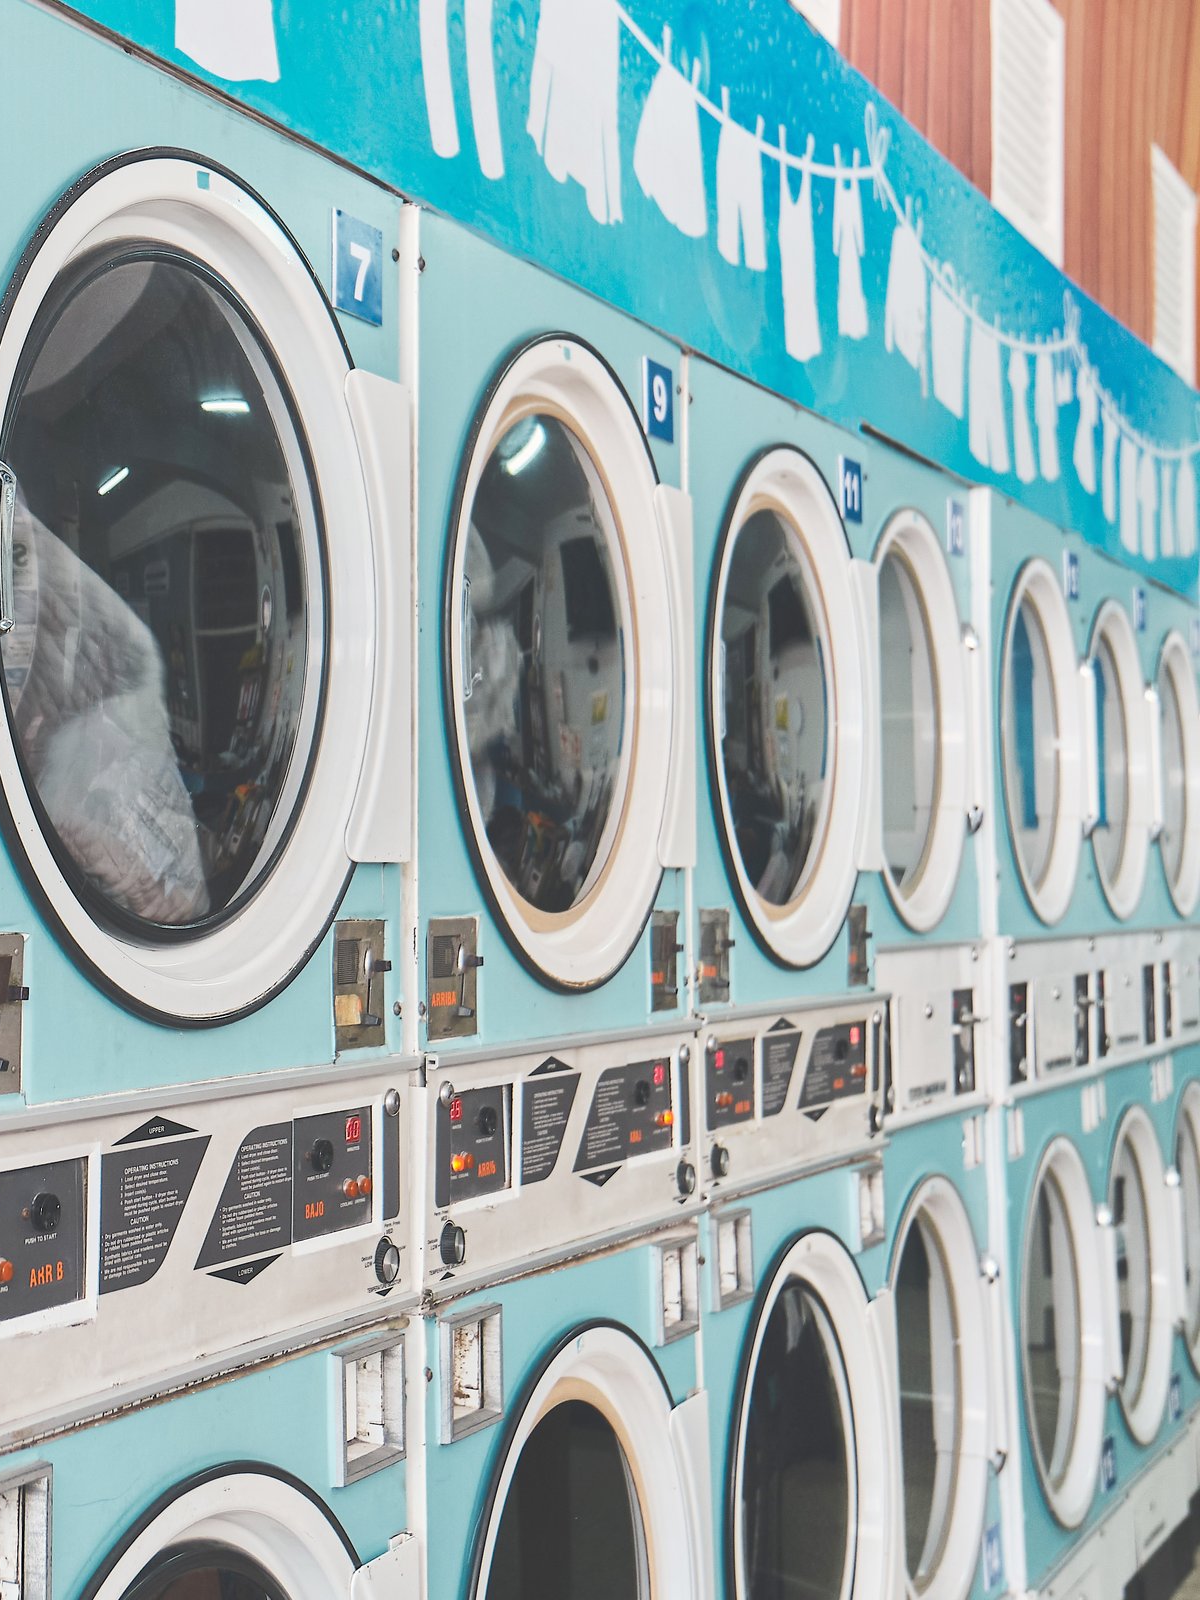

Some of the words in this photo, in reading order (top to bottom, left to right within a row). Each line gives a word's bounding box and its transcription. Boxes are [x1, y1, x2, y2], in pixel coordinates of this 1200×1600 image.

[350, 242, 371, 302] 7
[653, 375, 667, 422] 9
[845, 471, 858, 512] 11
[431, 991, 457, 1007] ARRIBA
[148, 1125, 165, 1134] UPPER
[240, 1142, 261, 1152] OPERATING
[262, 1138, 287, 1148] INSTRUCTIONS
[124, 1164, 148, 1174] OPERATING
[149, 1158, 178, 1169] INSTRUCTIONS
[244, 1191, 260, 1200] CAUTION
[305, 1201, 324, 1220] BAJO
[130, 1215, 149, 1225] CAUTION
[25, 1237, 36, 1245] PUSH
[43, 1233, 58, 1242] START
[56, 1260, 64, 1280] B
[237, 1267, 254, 1277] LOWER
